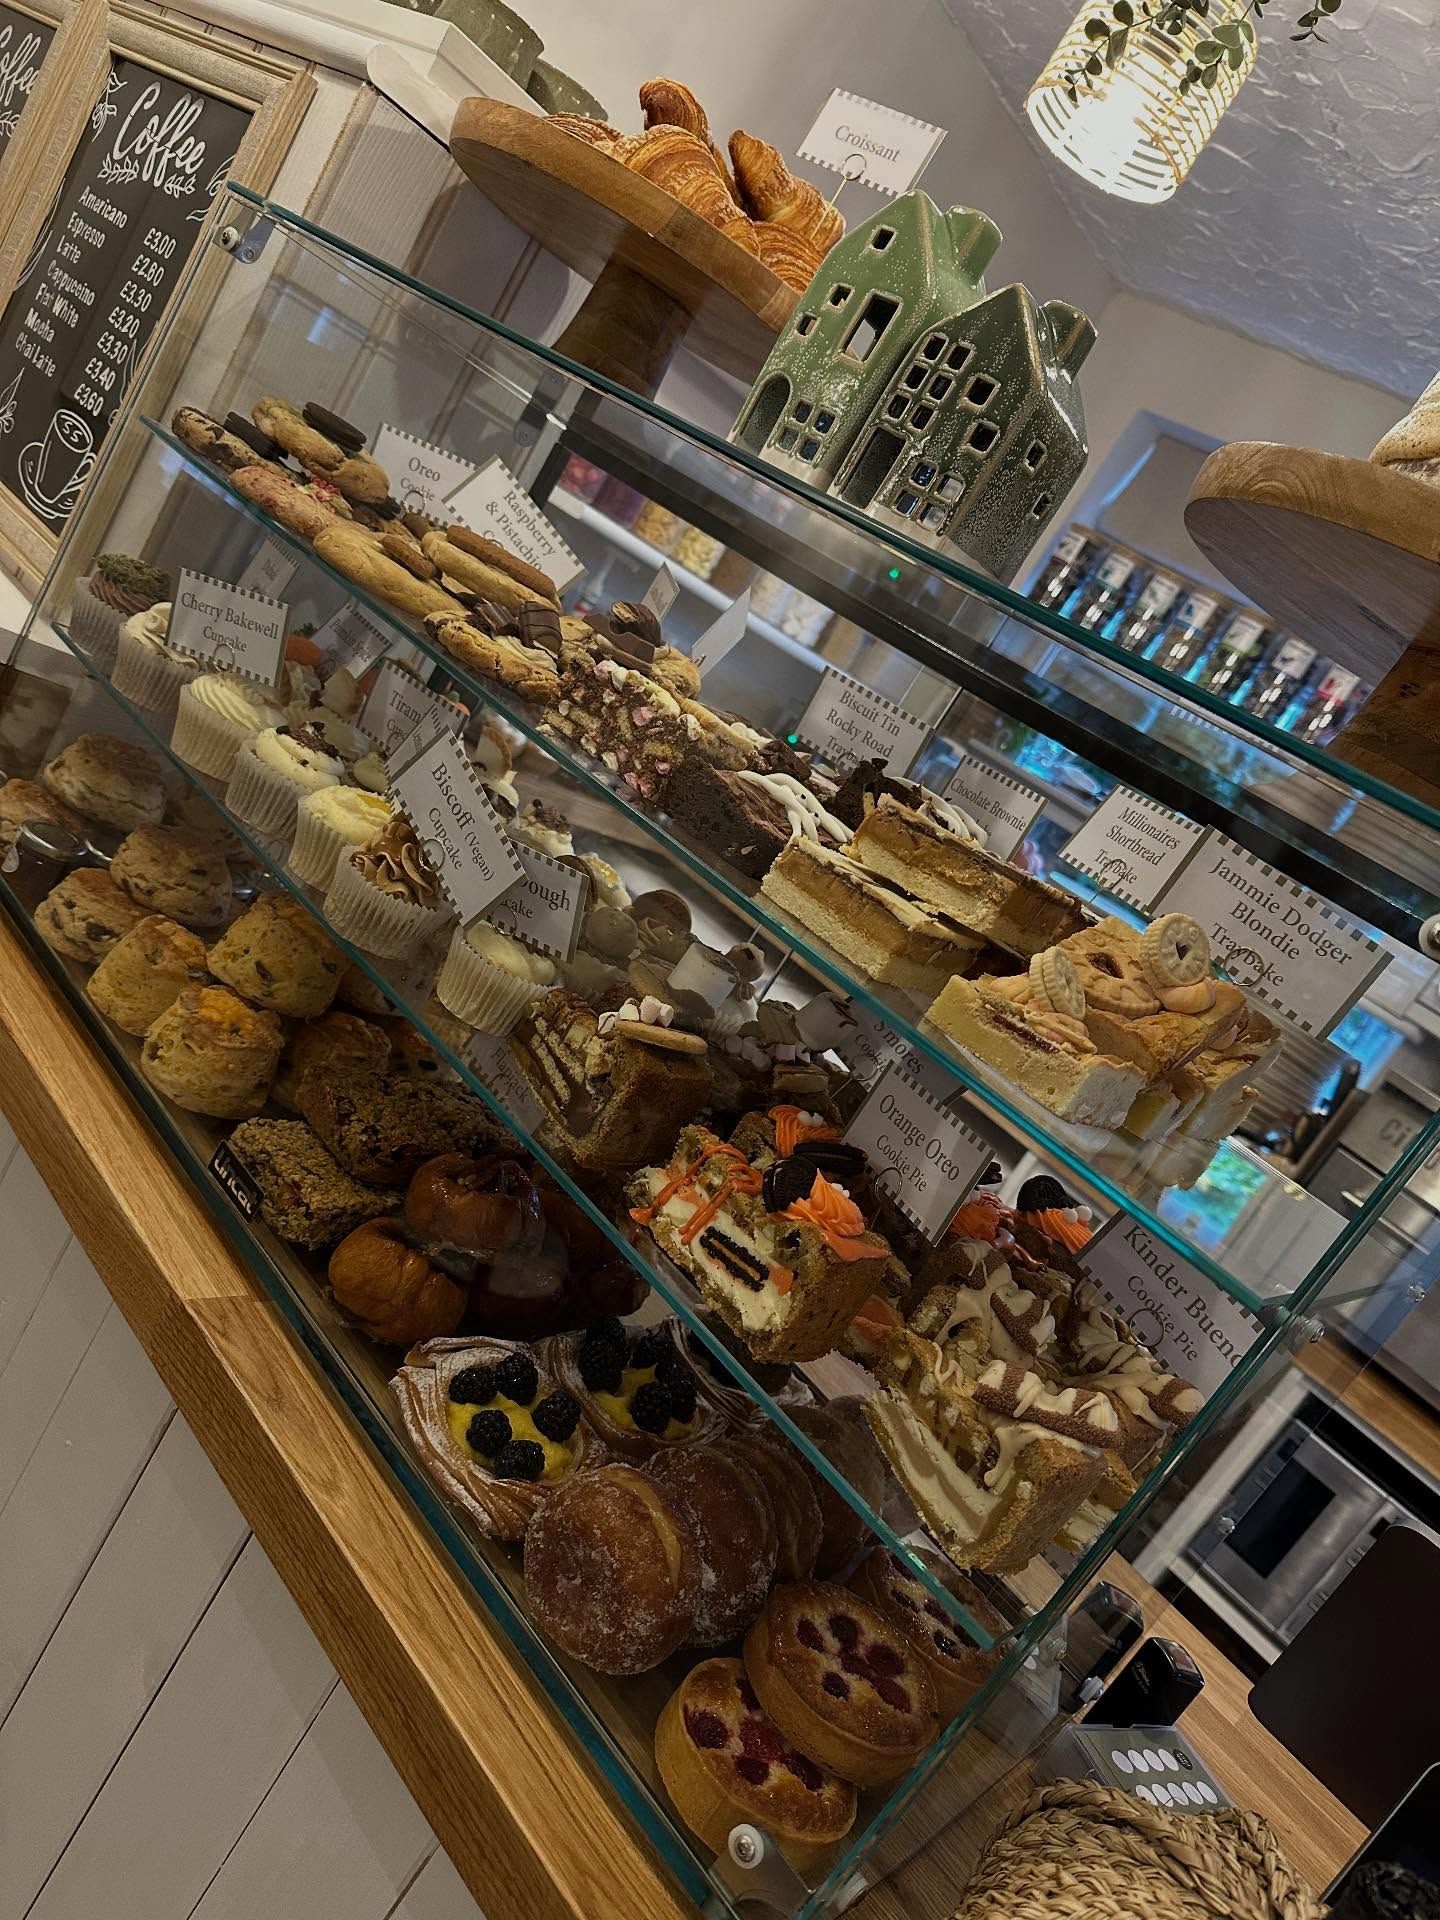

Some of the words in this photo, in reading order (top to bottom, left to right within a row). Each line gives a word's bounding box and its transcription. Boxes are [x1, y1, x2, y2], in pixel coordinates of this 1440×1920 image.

[113, 82, 206, 187] Coffee
[835, 125, 901, 162] Croissant
[79, 185, 128, 229] Americano
[67, 211, 106, 248] Espresso
[143, 227, 177, 259] £3.00
[47, 260, 95, 306] Cappuccino
[119, 280, 152, 313] £3.30
[24, 307, 55, 342] Mocha
[52, 293, 79, 328] White
[108, 306, 140, 339] £3.20
[15, 331, 37, 359] Chai
[32, 346, 56, 377] Latte
[97, 331, 128, 364] £3.30
[85, 357, 116, 391] £3.40
[74, 383, 104, 417] £3.60
[408, 457, 441, 482] Oreo
[485, 501, 499, 516] &
[497, 513, 543, 571] Pistachio
[503, 490, 559, 557] Raspberry
[180, 591, 224, 623] Cherry
[225, 607, 280, 640] Bakewell
[203, 625, 248, 653] Cupcake
[388, 689, 428, 723] Tiram
[839, 690, 882, 725] Biscuit
[879, 714, 902, 737] Tin
[825, 708, 862, 741] Rocky
[862, 732, 895, 759] Road
[431, 761, 476, 831] Biscoff
[464, 831, 494, 882] (Vegan)
[950, 778, 991, 810] Chocolate
[989, 800, 1027, 831] Brownie
[429, 807, 463, 870] Cupcake
[1105, 824, 1167, 866] Shortbread
[1117, 805, 1181, 849] Millionaires
[1094, 848, 1138, 885] Traybake
[500, 896, 534, 919] cake
[519, 878, 571, 911] ough
[1208, 856, 1281, 914] Jammie
[1279, 904, 1353, 966] Dodger
[1229, 900, 1301, 961] Blondie
[1209, 922, 1285, 987] Traybake
[879, 1094, 928, 1148] Orange
[925, 1137, 961, 1181] Oreo
[876, 1134, 911, 1175] Cookie
[910, 1167, 928, 1192] Pie
[1121, 1223, 1188, 1299] Kinder
[1127, 1275, 1175, 1333] Cookie
[1173, 1329, 1200, 1361] Pie
